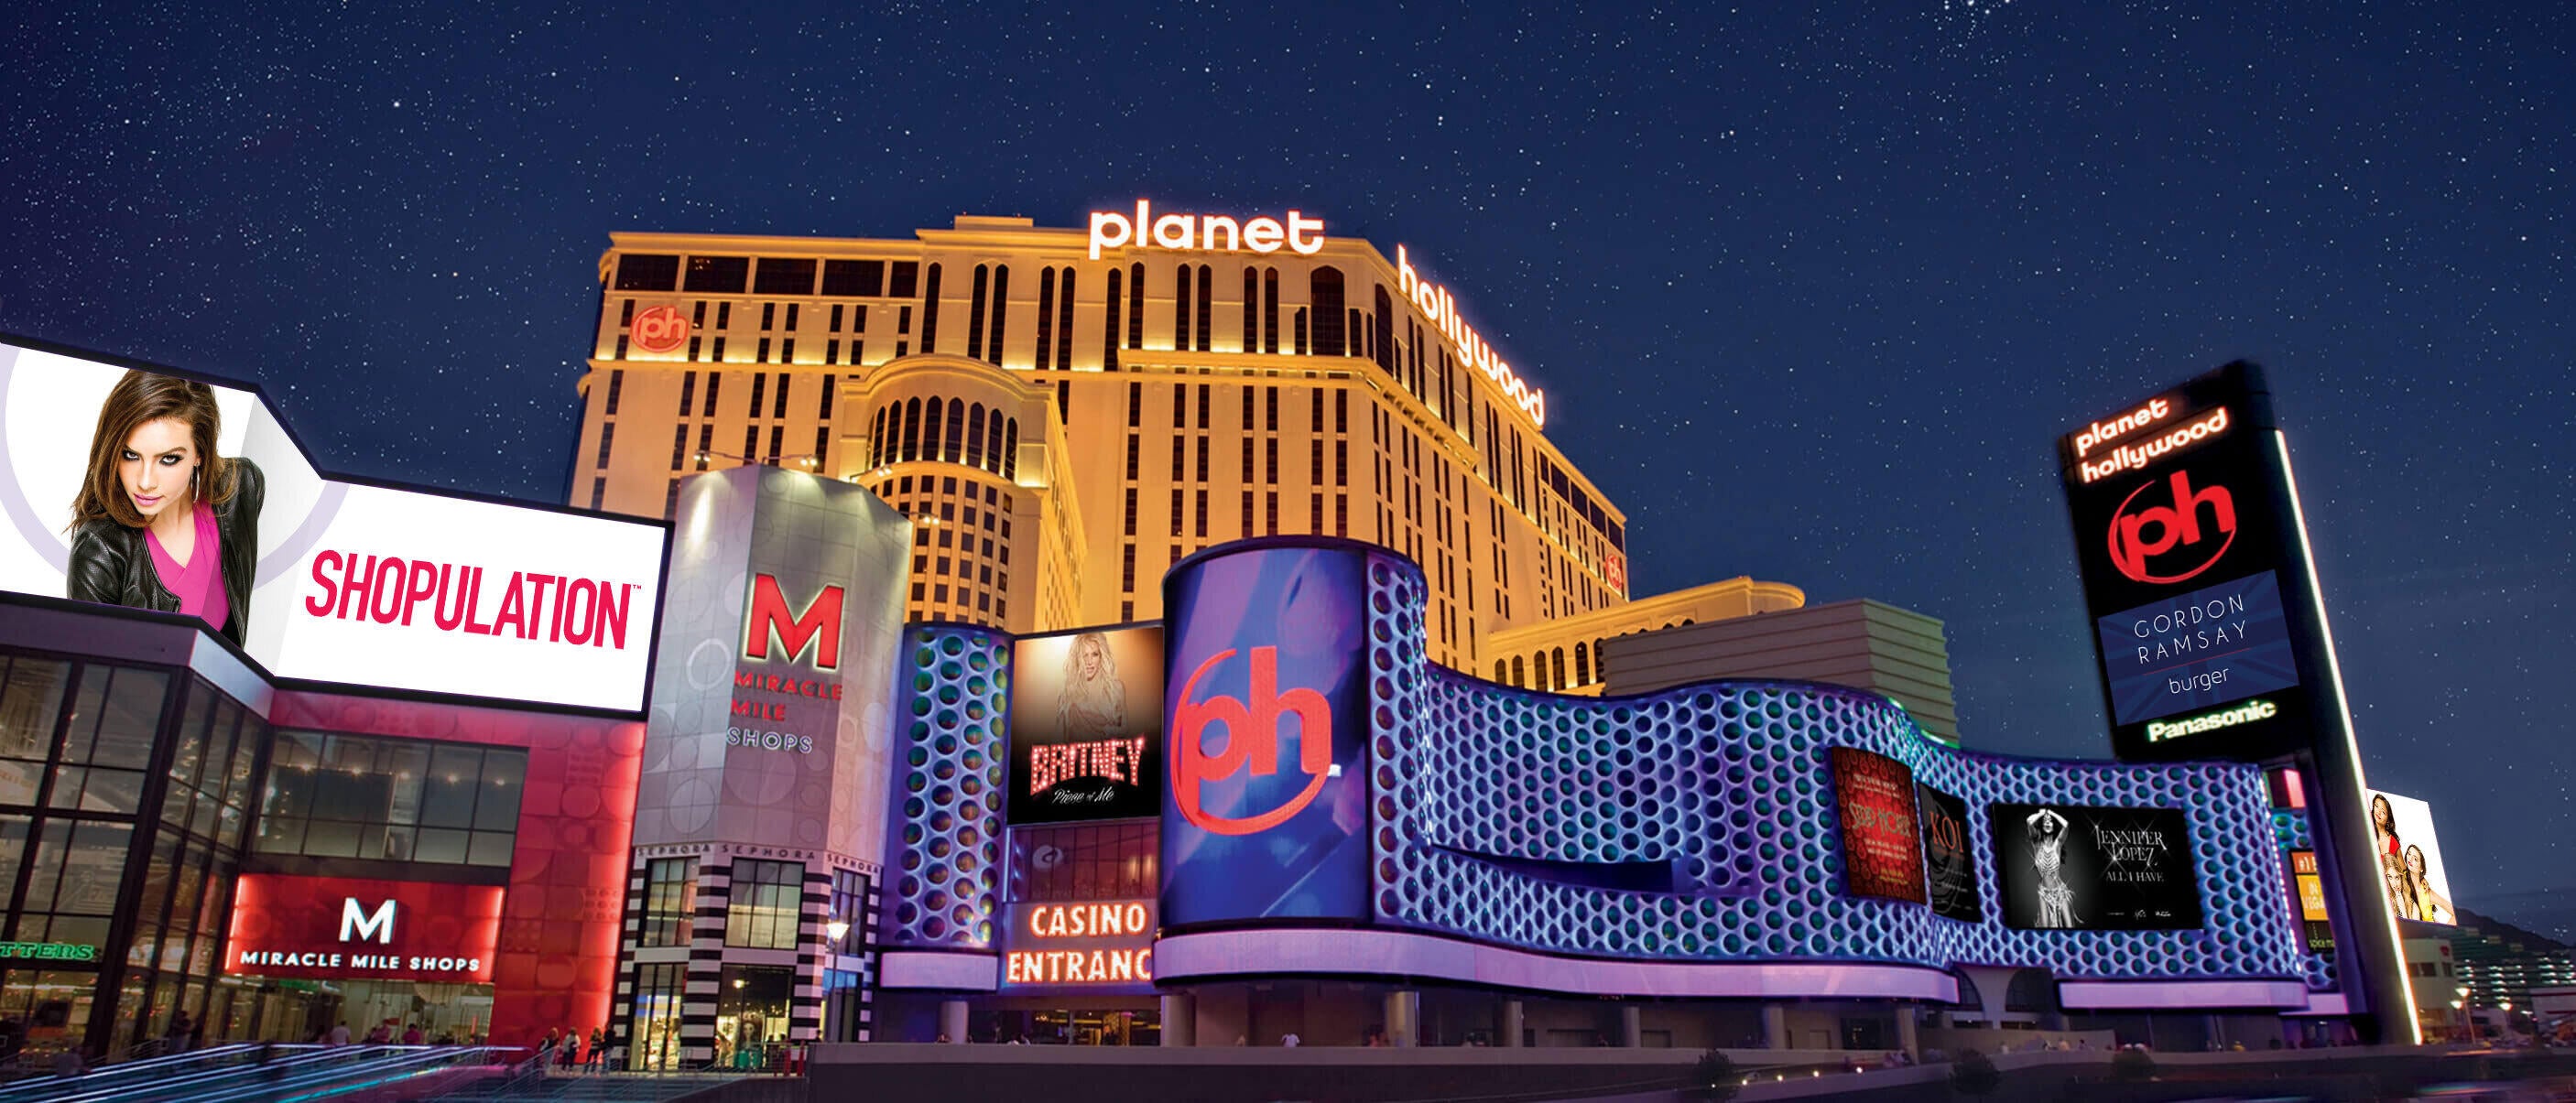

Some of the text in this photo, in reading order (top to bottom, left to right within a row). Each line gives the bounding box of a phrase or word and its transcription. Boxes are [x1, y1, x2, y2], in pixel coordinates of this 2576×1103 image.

[1088, 199, 1325, 261] planet
[639, 306, 688, 345] ph
[1397, 243, 1545, 427] hollywood
[2076, 398, 2169, 458] planet
[2081, 406, 2229, 483] hollywood
[2116, 470, 2237, 579] ph
[304, 549, 632, 650] SHOPULATION
[2134, 593, 2244, 639] GORDON
[2137, 619, 2248, 665] RAMSAY
[734, 669, 842, 701] MIRACLE
[2168, 667, 2230, 695] burger
[730, 697, 786, 722] MILE
[2147, 699, 2277, 742] Panasonic
[726, 726, 813, 754] SHOPS
[1176, 645, 1332, 822] ph
[1029, 735, 1145, 797] BRITNEY
[637, 843, 712, 858] SEPHORA
[722, 843, 815, 860] SEPHORA
[1929, 811, 1964, 853] KOI
[2094, 825, 2168, 850] JENNIFER
[826, 852, 879, 875] SEPHORA
[2111, 842, 2155, 866] LOPEZ
[339, 896, 397, 945] M
[1029, 901, 1148, 937] CASINO
[239, 950, 481, 973] MIRACLE MILE SHOPS
